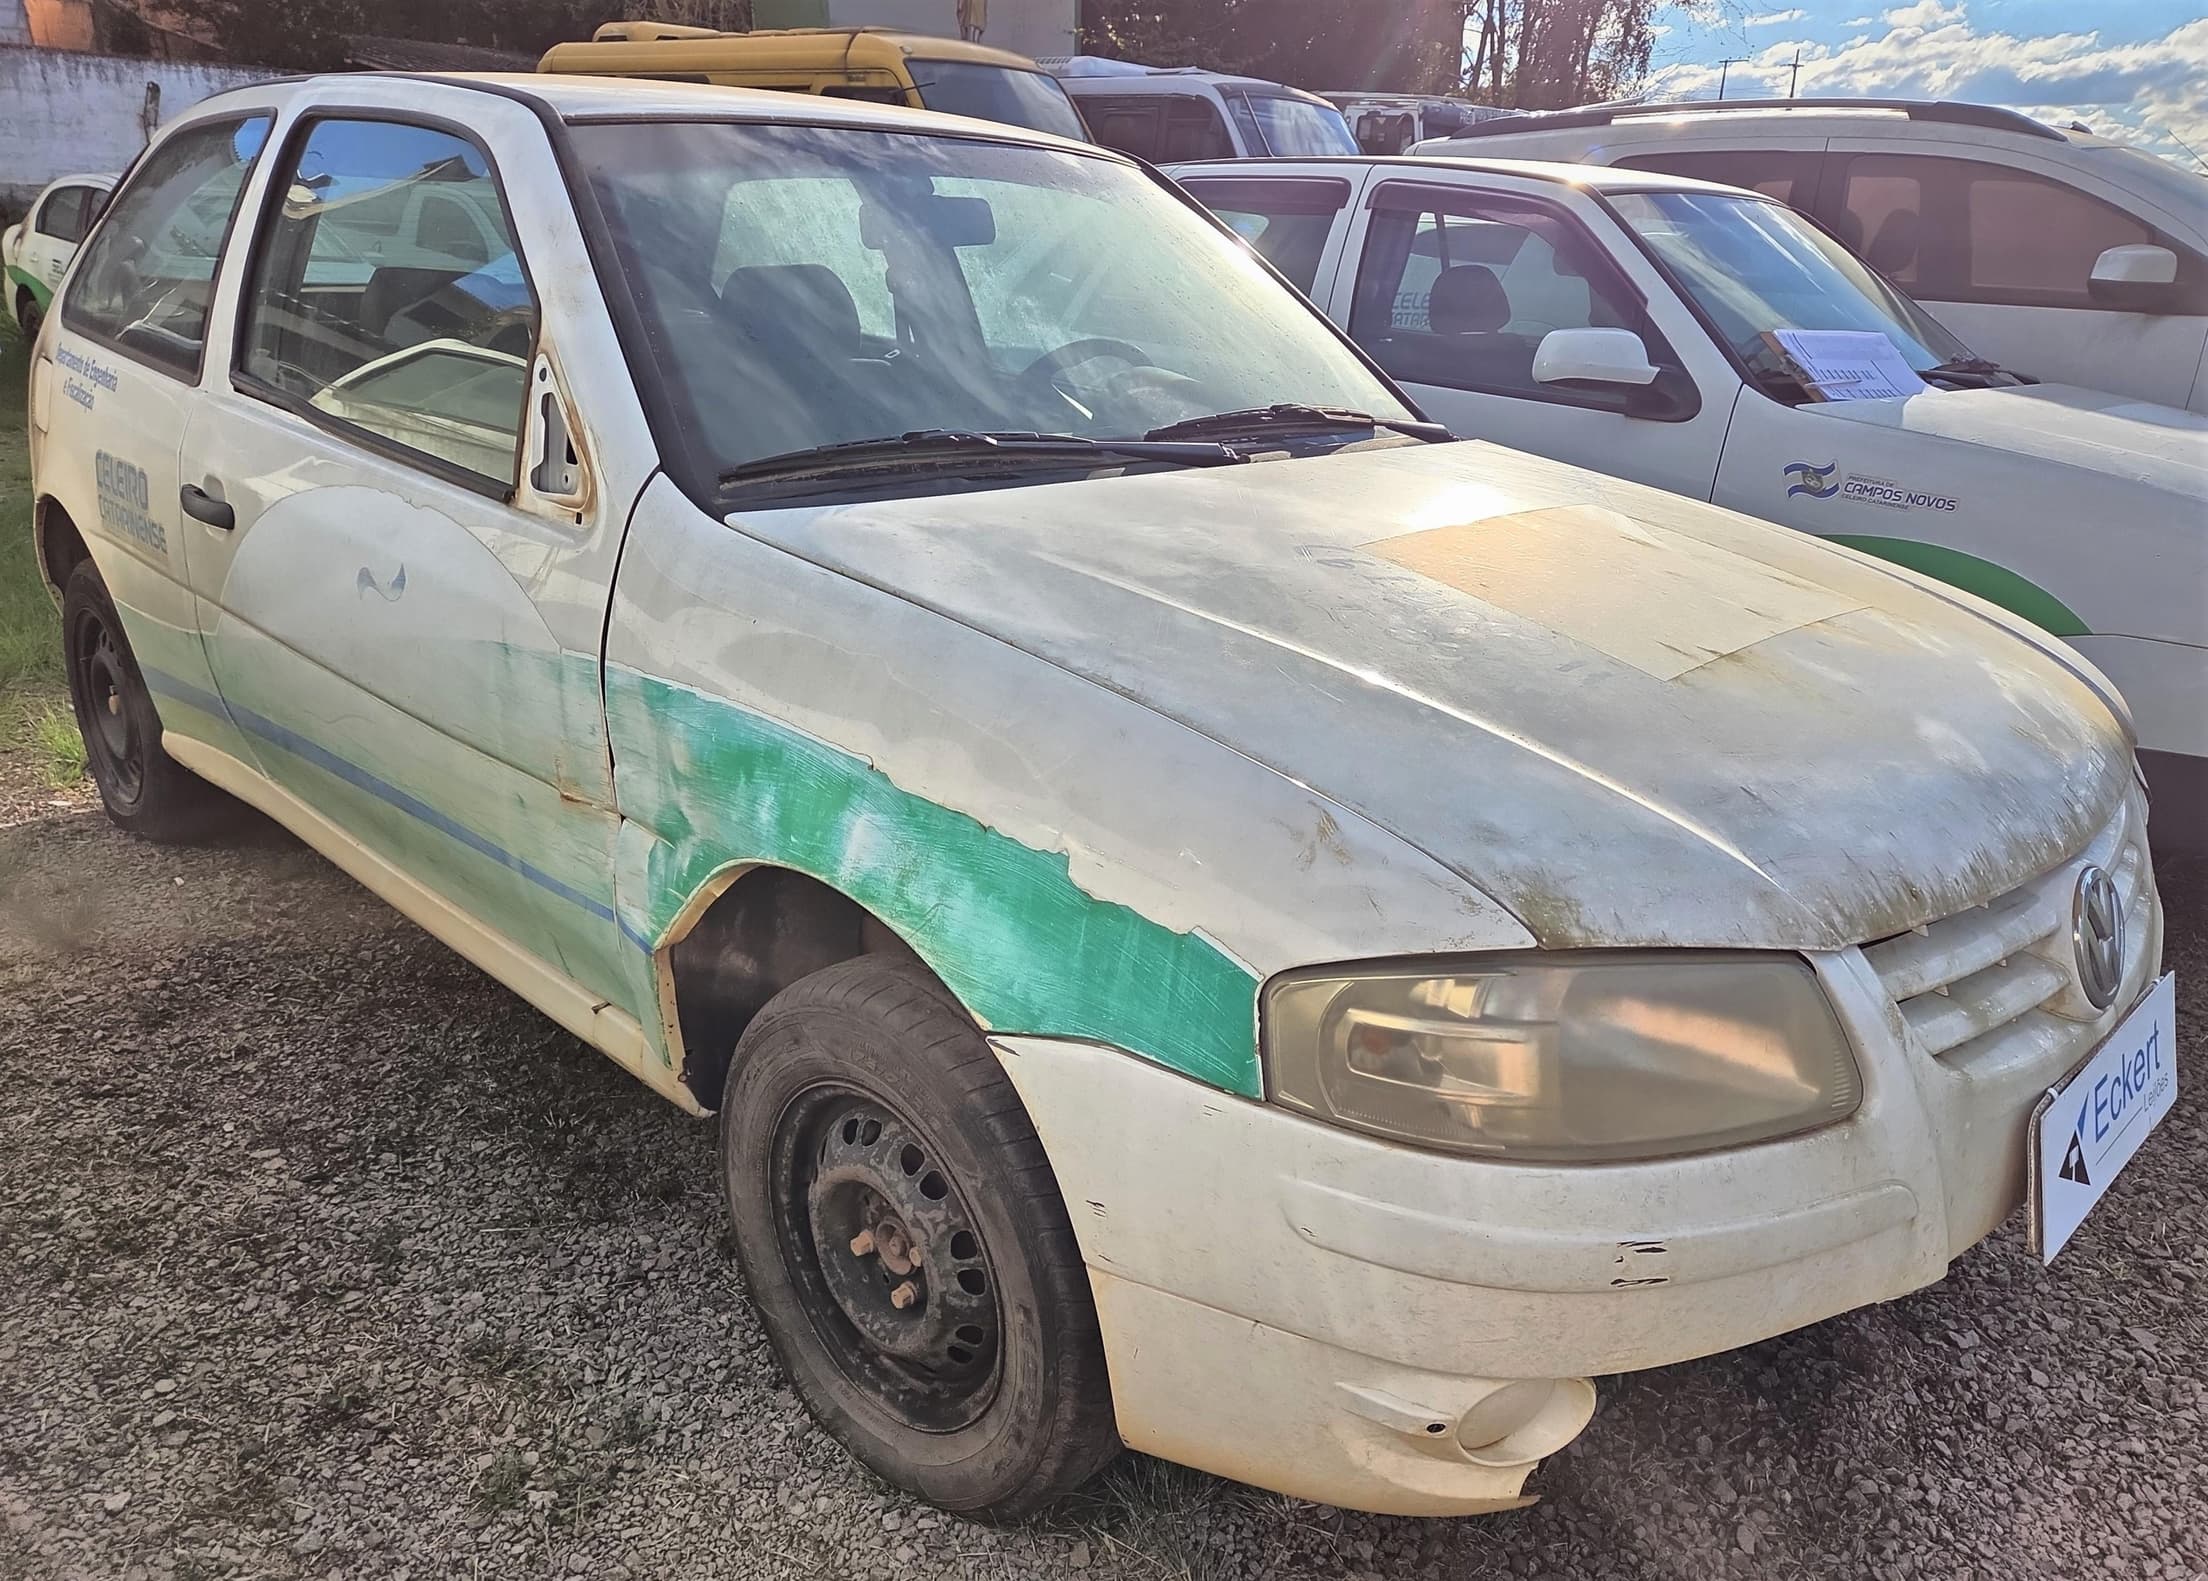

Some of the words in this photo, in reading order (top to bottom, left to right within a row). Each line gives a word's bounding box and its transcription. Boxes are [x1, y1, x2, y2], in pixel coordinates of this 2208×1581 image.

[96, 449, 148, 511] CELEIRO
[1841, 493, 1867, 502] CELEIRO
[1844, 482, 1903, 501] CAMPOS
[1905, 492, 1957, 511] NOVOS
[98, 493, 168, 555] CATARINENSE
[2094, 1018, 2160, 1144] Eckert
